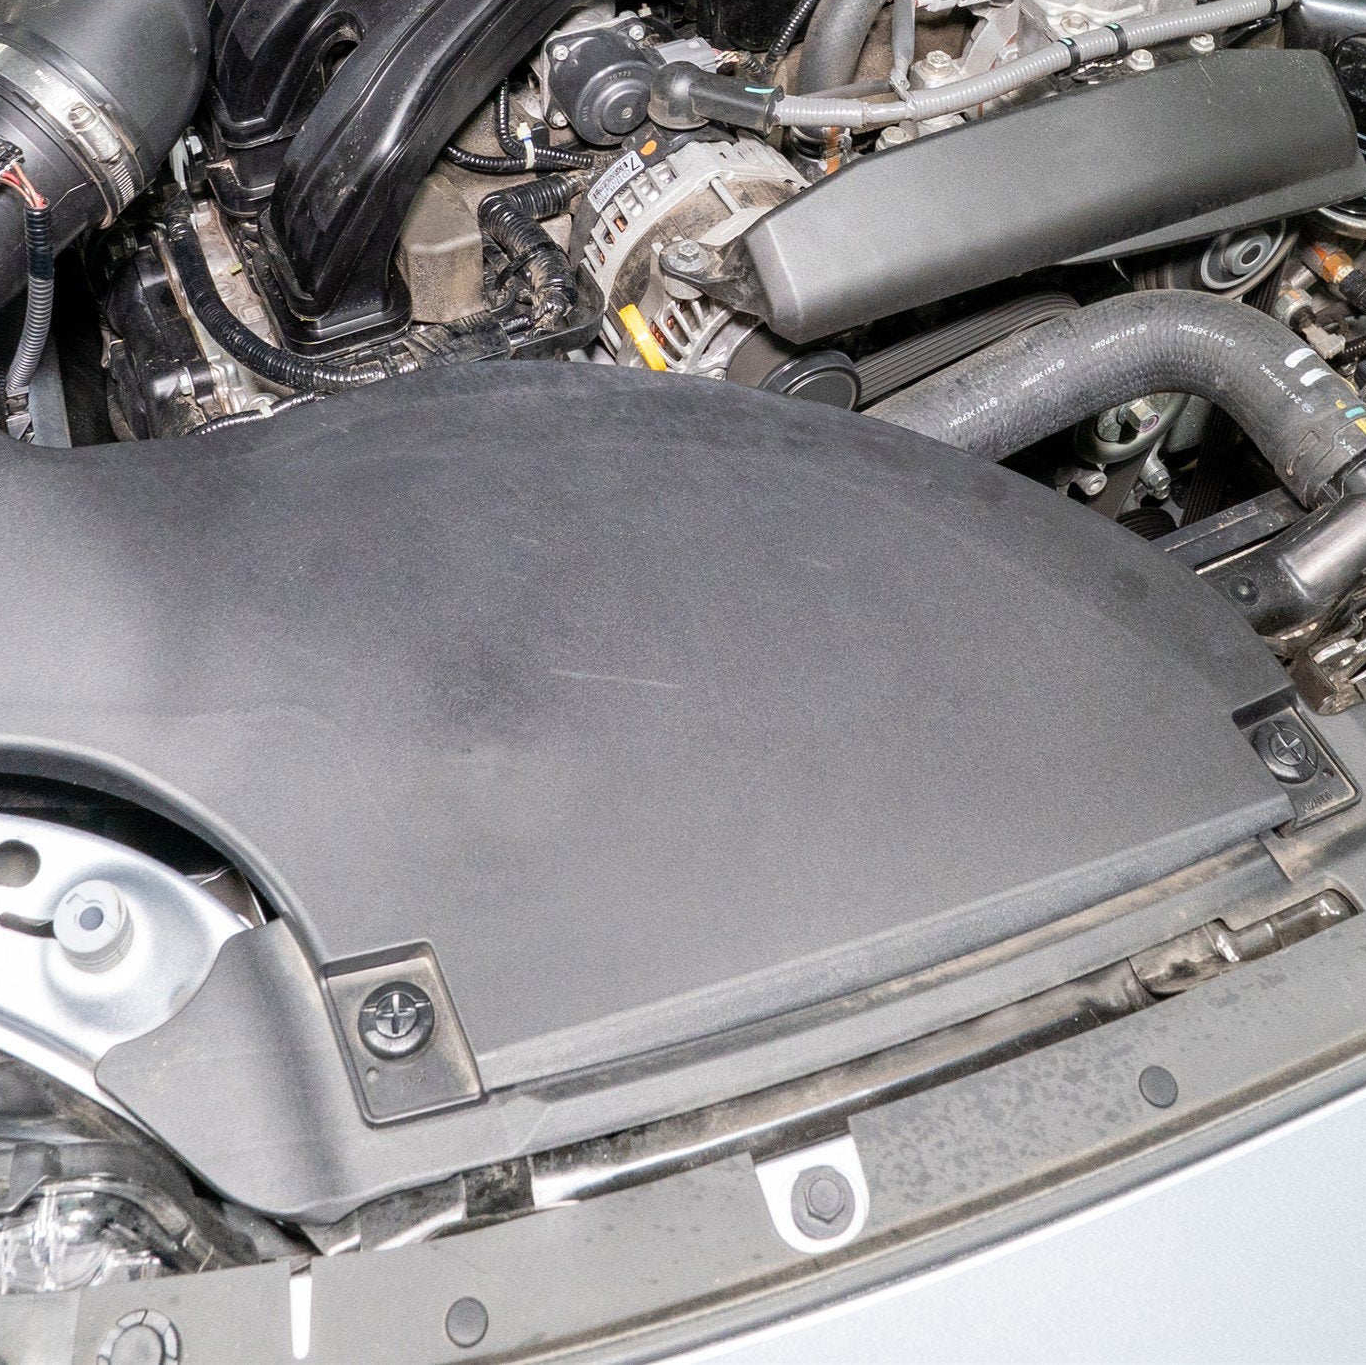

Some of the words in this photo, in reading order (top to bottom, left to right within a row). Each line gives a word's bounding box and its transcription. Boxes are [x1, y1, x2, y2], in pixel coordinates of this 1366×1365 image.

[1120, 326, 1135, 336] 241
[1209, 330, 1225, 341] 241
[1043, 363, 1056, 375] 241
[1285, 388, 1302, 404] 241
[974, 401, 989, 413] 241
